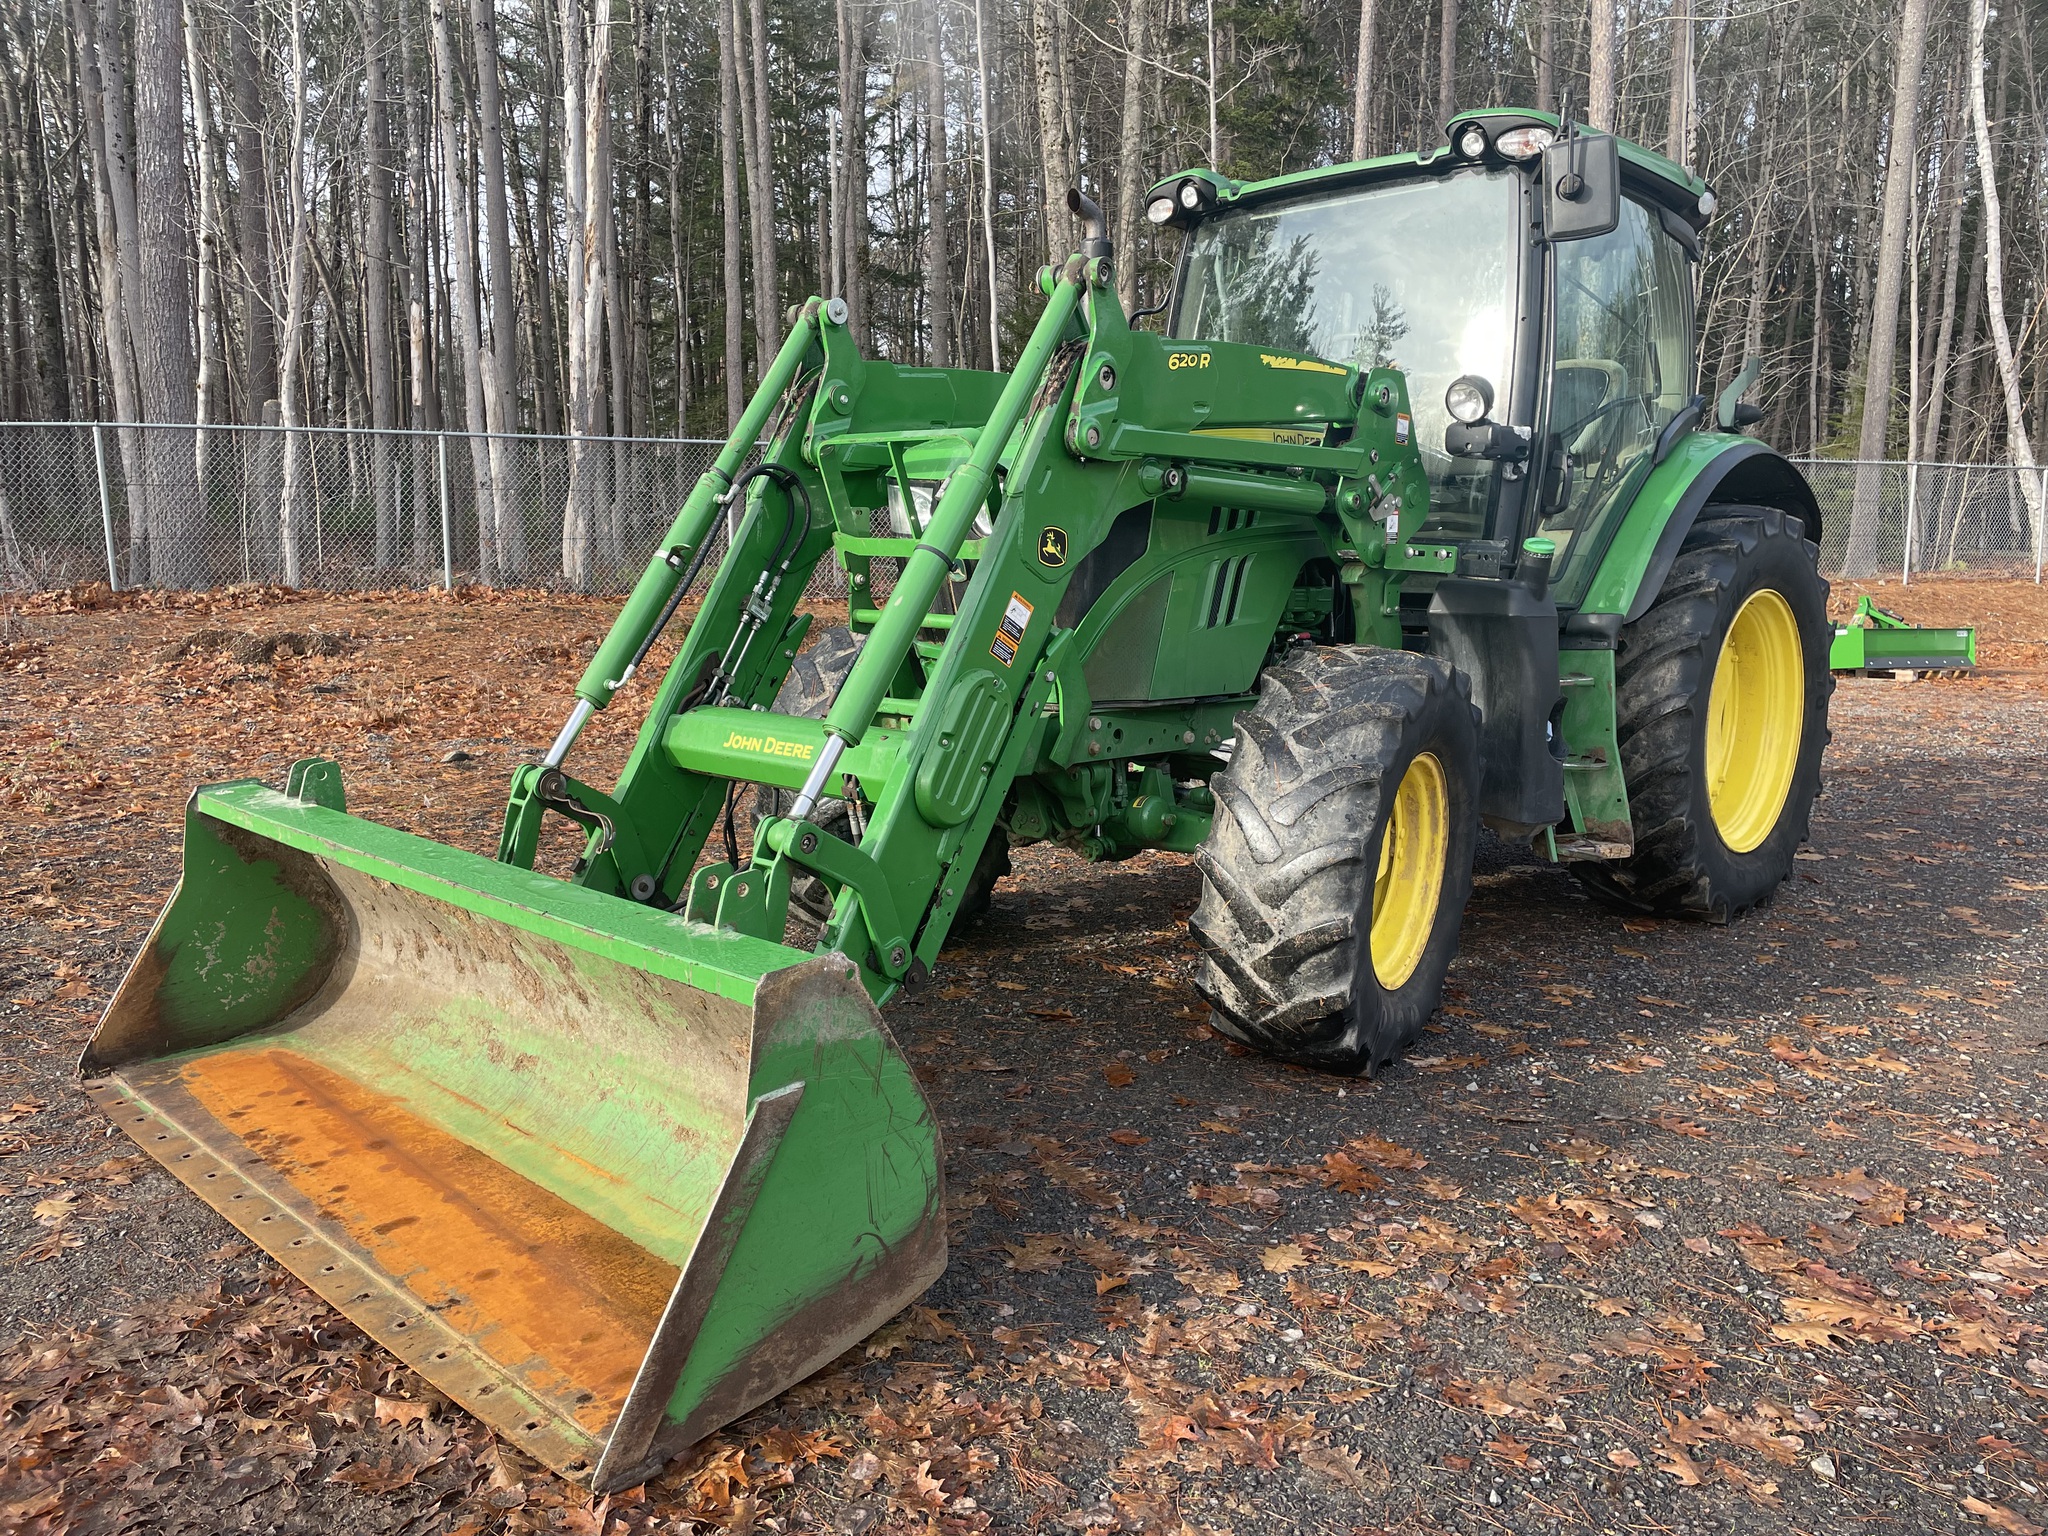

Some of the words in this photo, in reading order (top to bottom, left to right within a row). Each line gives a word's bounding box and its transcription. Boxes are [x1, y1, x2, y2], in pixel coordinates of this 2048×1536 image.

[1273, 432, 1296, 445] JOHN
[723, 731, 762, 752] JOHN
[763, 736, 814, 760] DEERE
